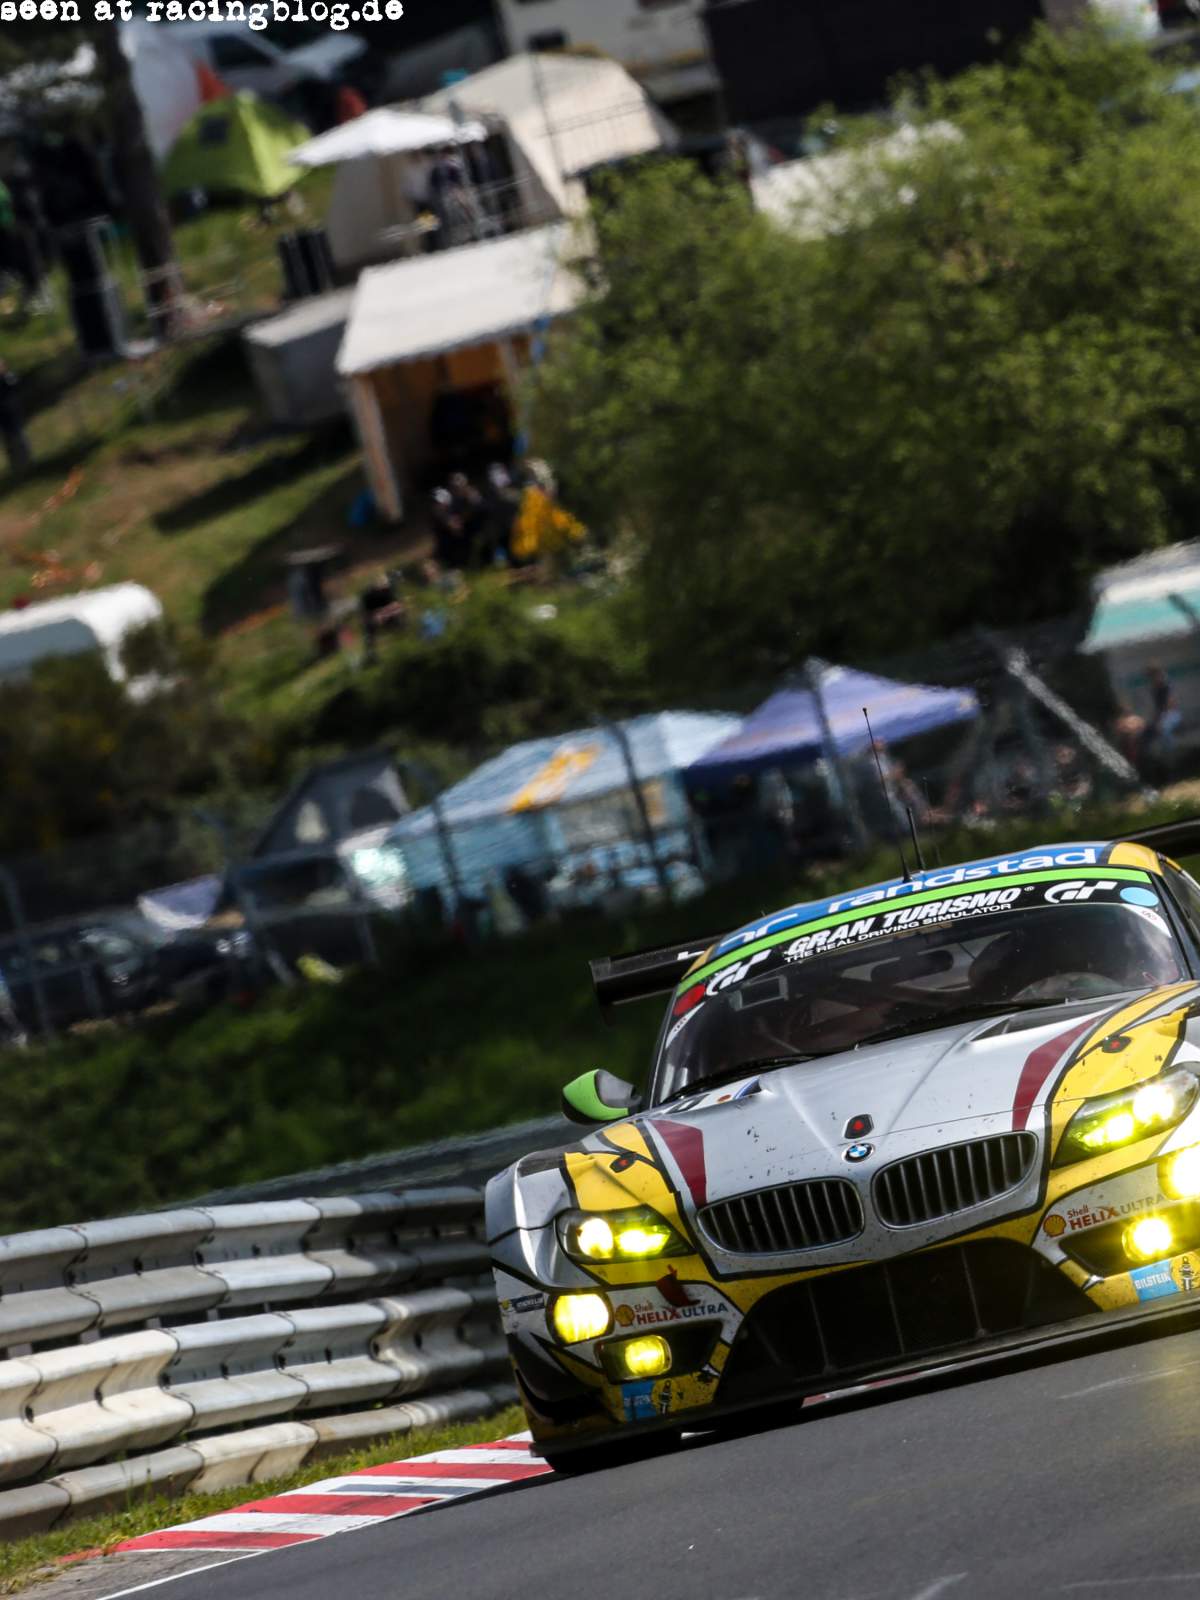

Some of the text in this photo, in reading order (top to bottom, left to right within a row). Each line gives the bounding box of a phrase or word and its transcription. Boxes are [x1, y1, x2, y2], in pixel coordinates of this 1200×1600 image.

[828, 848, 1097, 914] randstad
[784, 886, 1022, 956] GRAN TURISMO
[784, 903, 1012, 964] THE REAL DRIVING SIMULATOR
[1066, 1203, 1089, 1219] Shell
[1069, 1193, 1165, 1231] HELIX ULTRA
[1133, 1270, 1172, 1290] BILSTEIN
[636, 1302, 729, 1326] HELIX ULTRA
